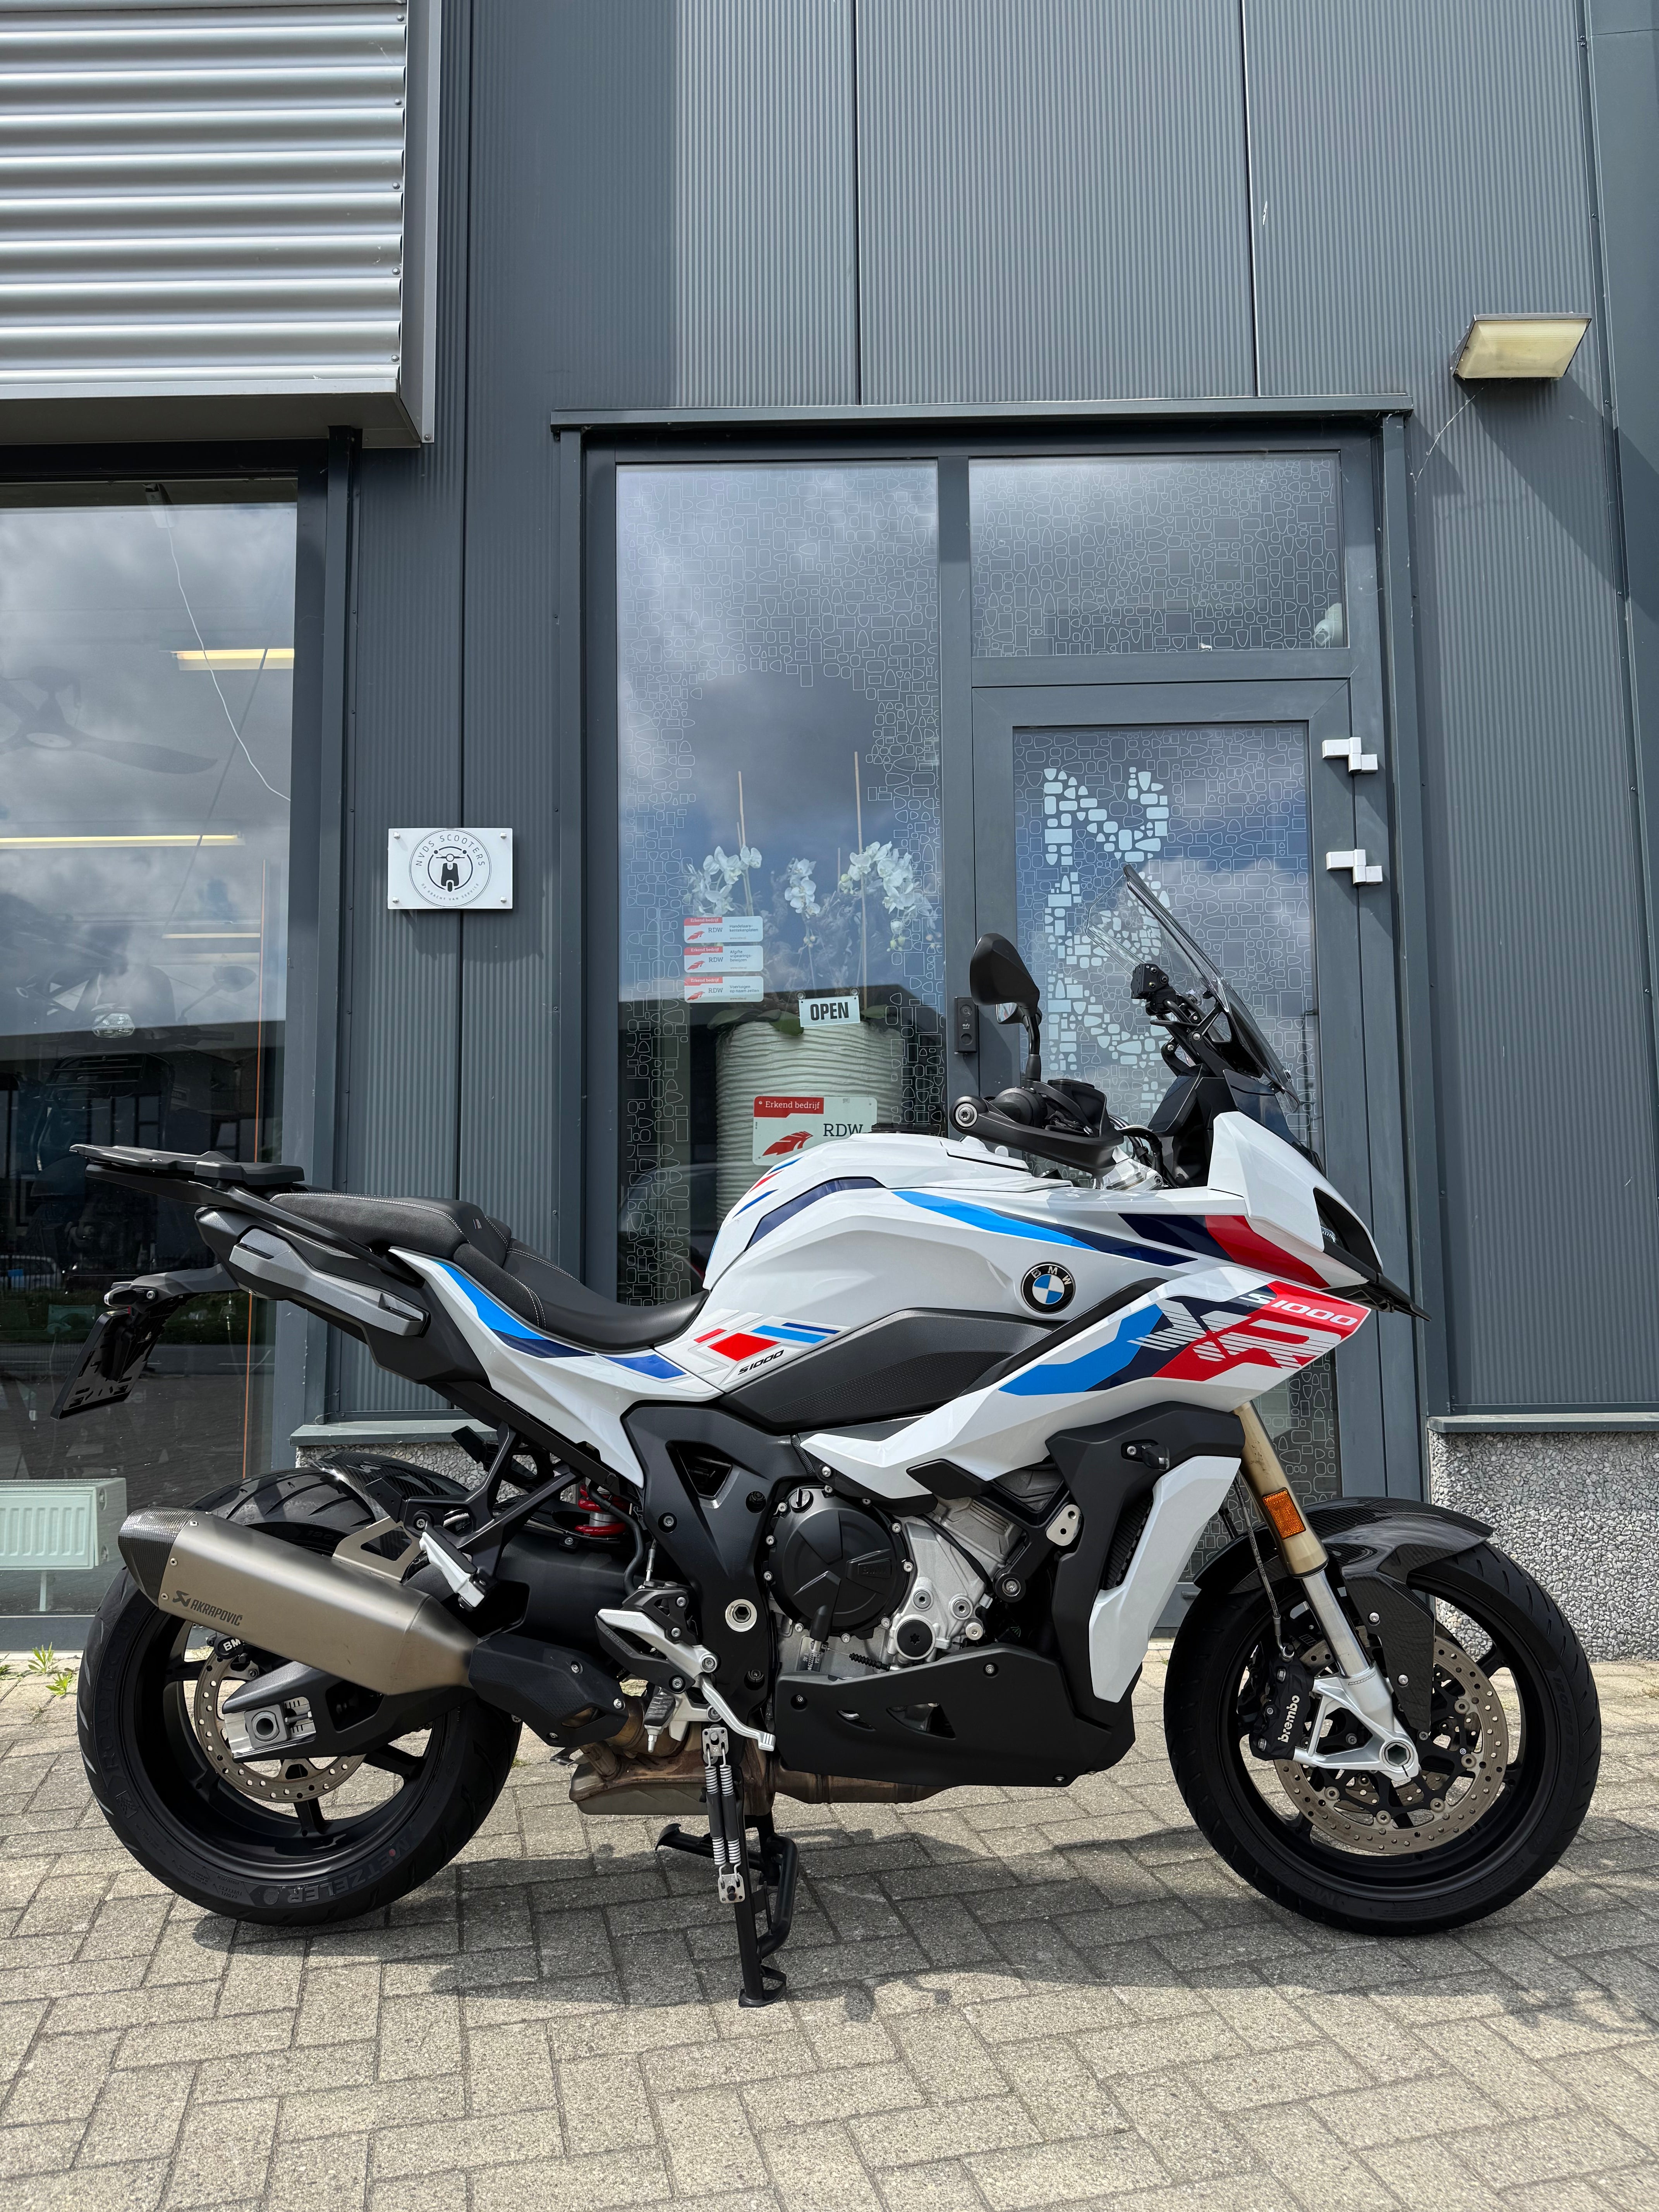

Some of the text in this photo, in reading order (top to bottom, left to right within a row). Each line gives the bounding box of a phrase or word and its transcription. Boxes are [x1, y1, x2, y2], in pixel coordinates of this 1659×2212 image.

[416, 834, 485, 866] NVDS SCOOTERS
[461, 883, 479, 898] SERVICE
[810, 1002, 849, 1021] OPEN
[795, 1101, 820, 1110] bedrijf
[823, 1123, 863, 1137] RDW
[1030, 1266, 1072, 1285] BMW
[738, 1349, 784, 1376] S1000
[223, 1638, 245, 1652] BM
[1277, 1695, 1300, 1743] brembo
